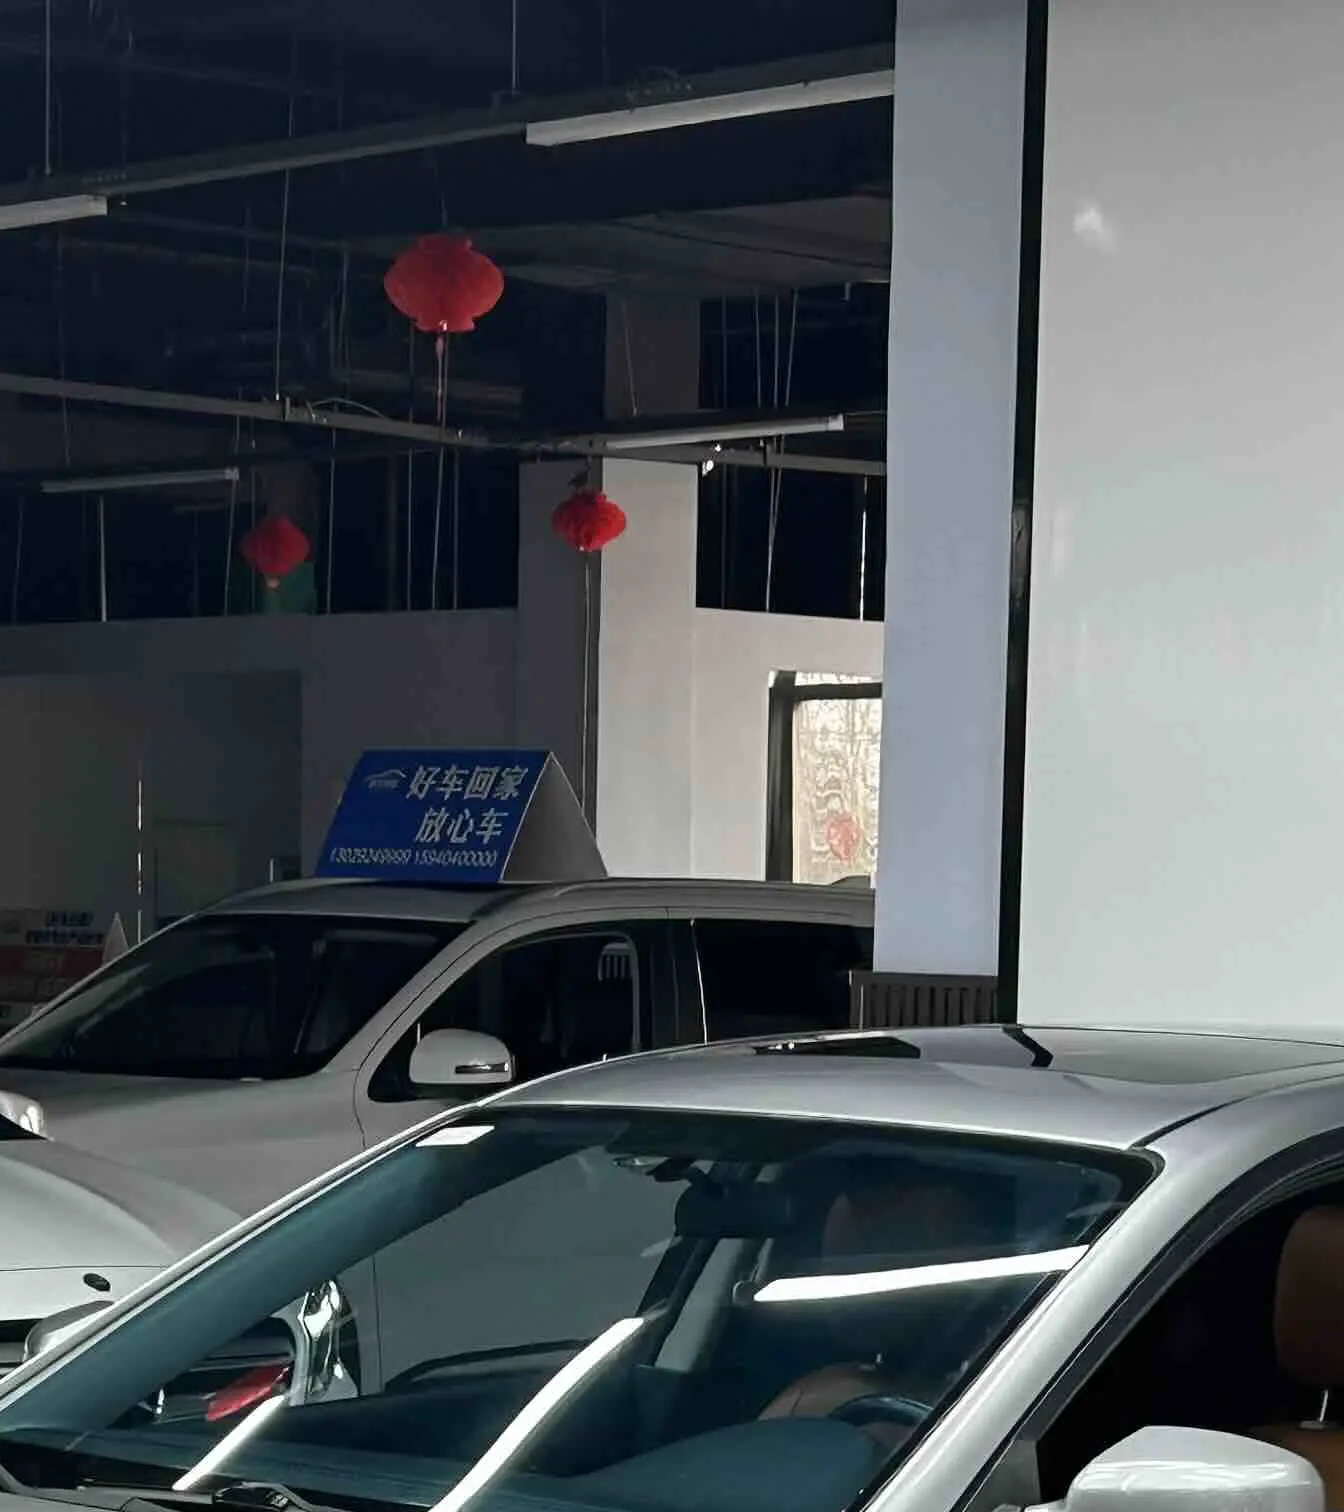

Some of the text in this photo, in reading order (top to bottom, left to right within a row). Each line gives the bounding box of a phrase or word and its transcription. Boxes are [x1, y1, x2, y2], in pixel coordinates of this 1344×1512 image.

[405, 763, 529, 802] 好车回家
[414, 806, 509, 845] 放心车
